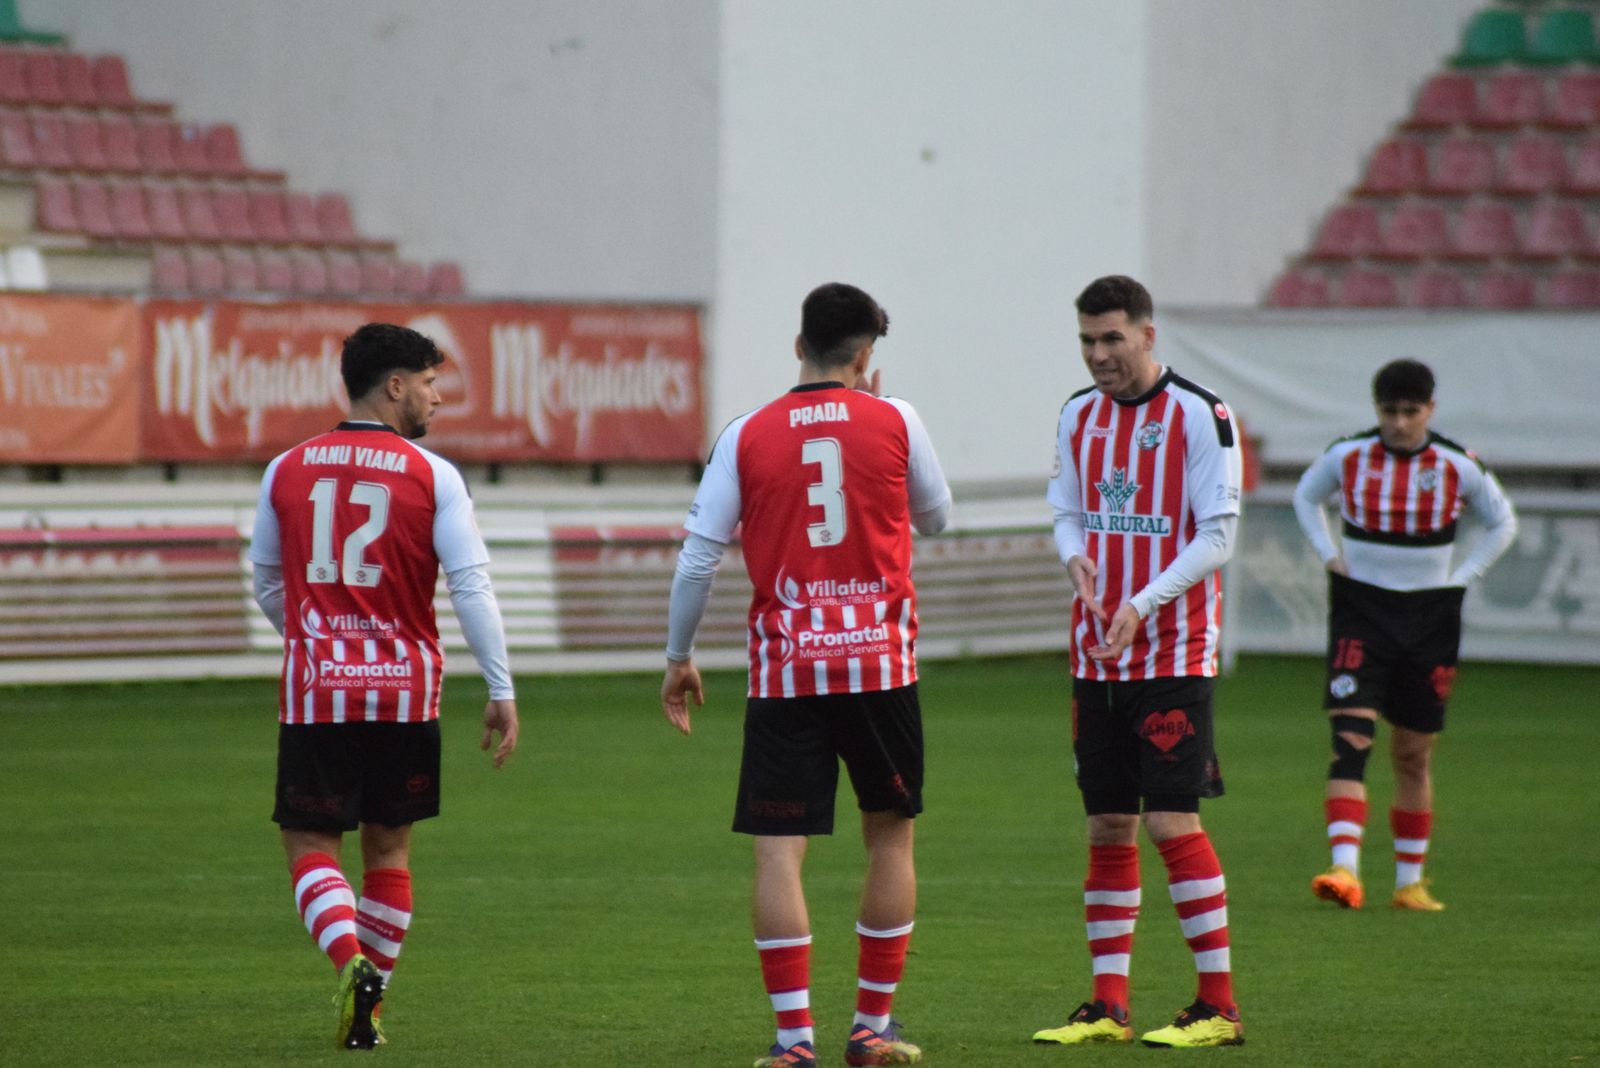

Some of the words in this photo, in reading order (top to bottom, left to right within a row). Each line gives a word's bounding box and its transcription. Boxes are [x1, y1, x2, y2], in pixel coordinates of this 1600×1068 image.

[155, 303, 349, 447] Melquiad
[789, 402, 849, 428] PRADA
[303, 445, 352, 466] MANU
[354, 446, 408, 473] VIANA
[802, 437, 847, 548] 3
[306, 478, 391, 587] 12
[1108, 514, 1169, 534] RURAL
[805, 576, 887, 598] Villafuel
[809, 594, 877, 607] COMBUSTIBLES
[798, 623, 889, 647] Pronatal
[800, 646, 844, 658] Medical
[848, 643, 889, 655] Services
[319, 660, 412, 677] Pronatal
[319, 678, 364, 688] Medical
[367, 678, 412, 688] Services
